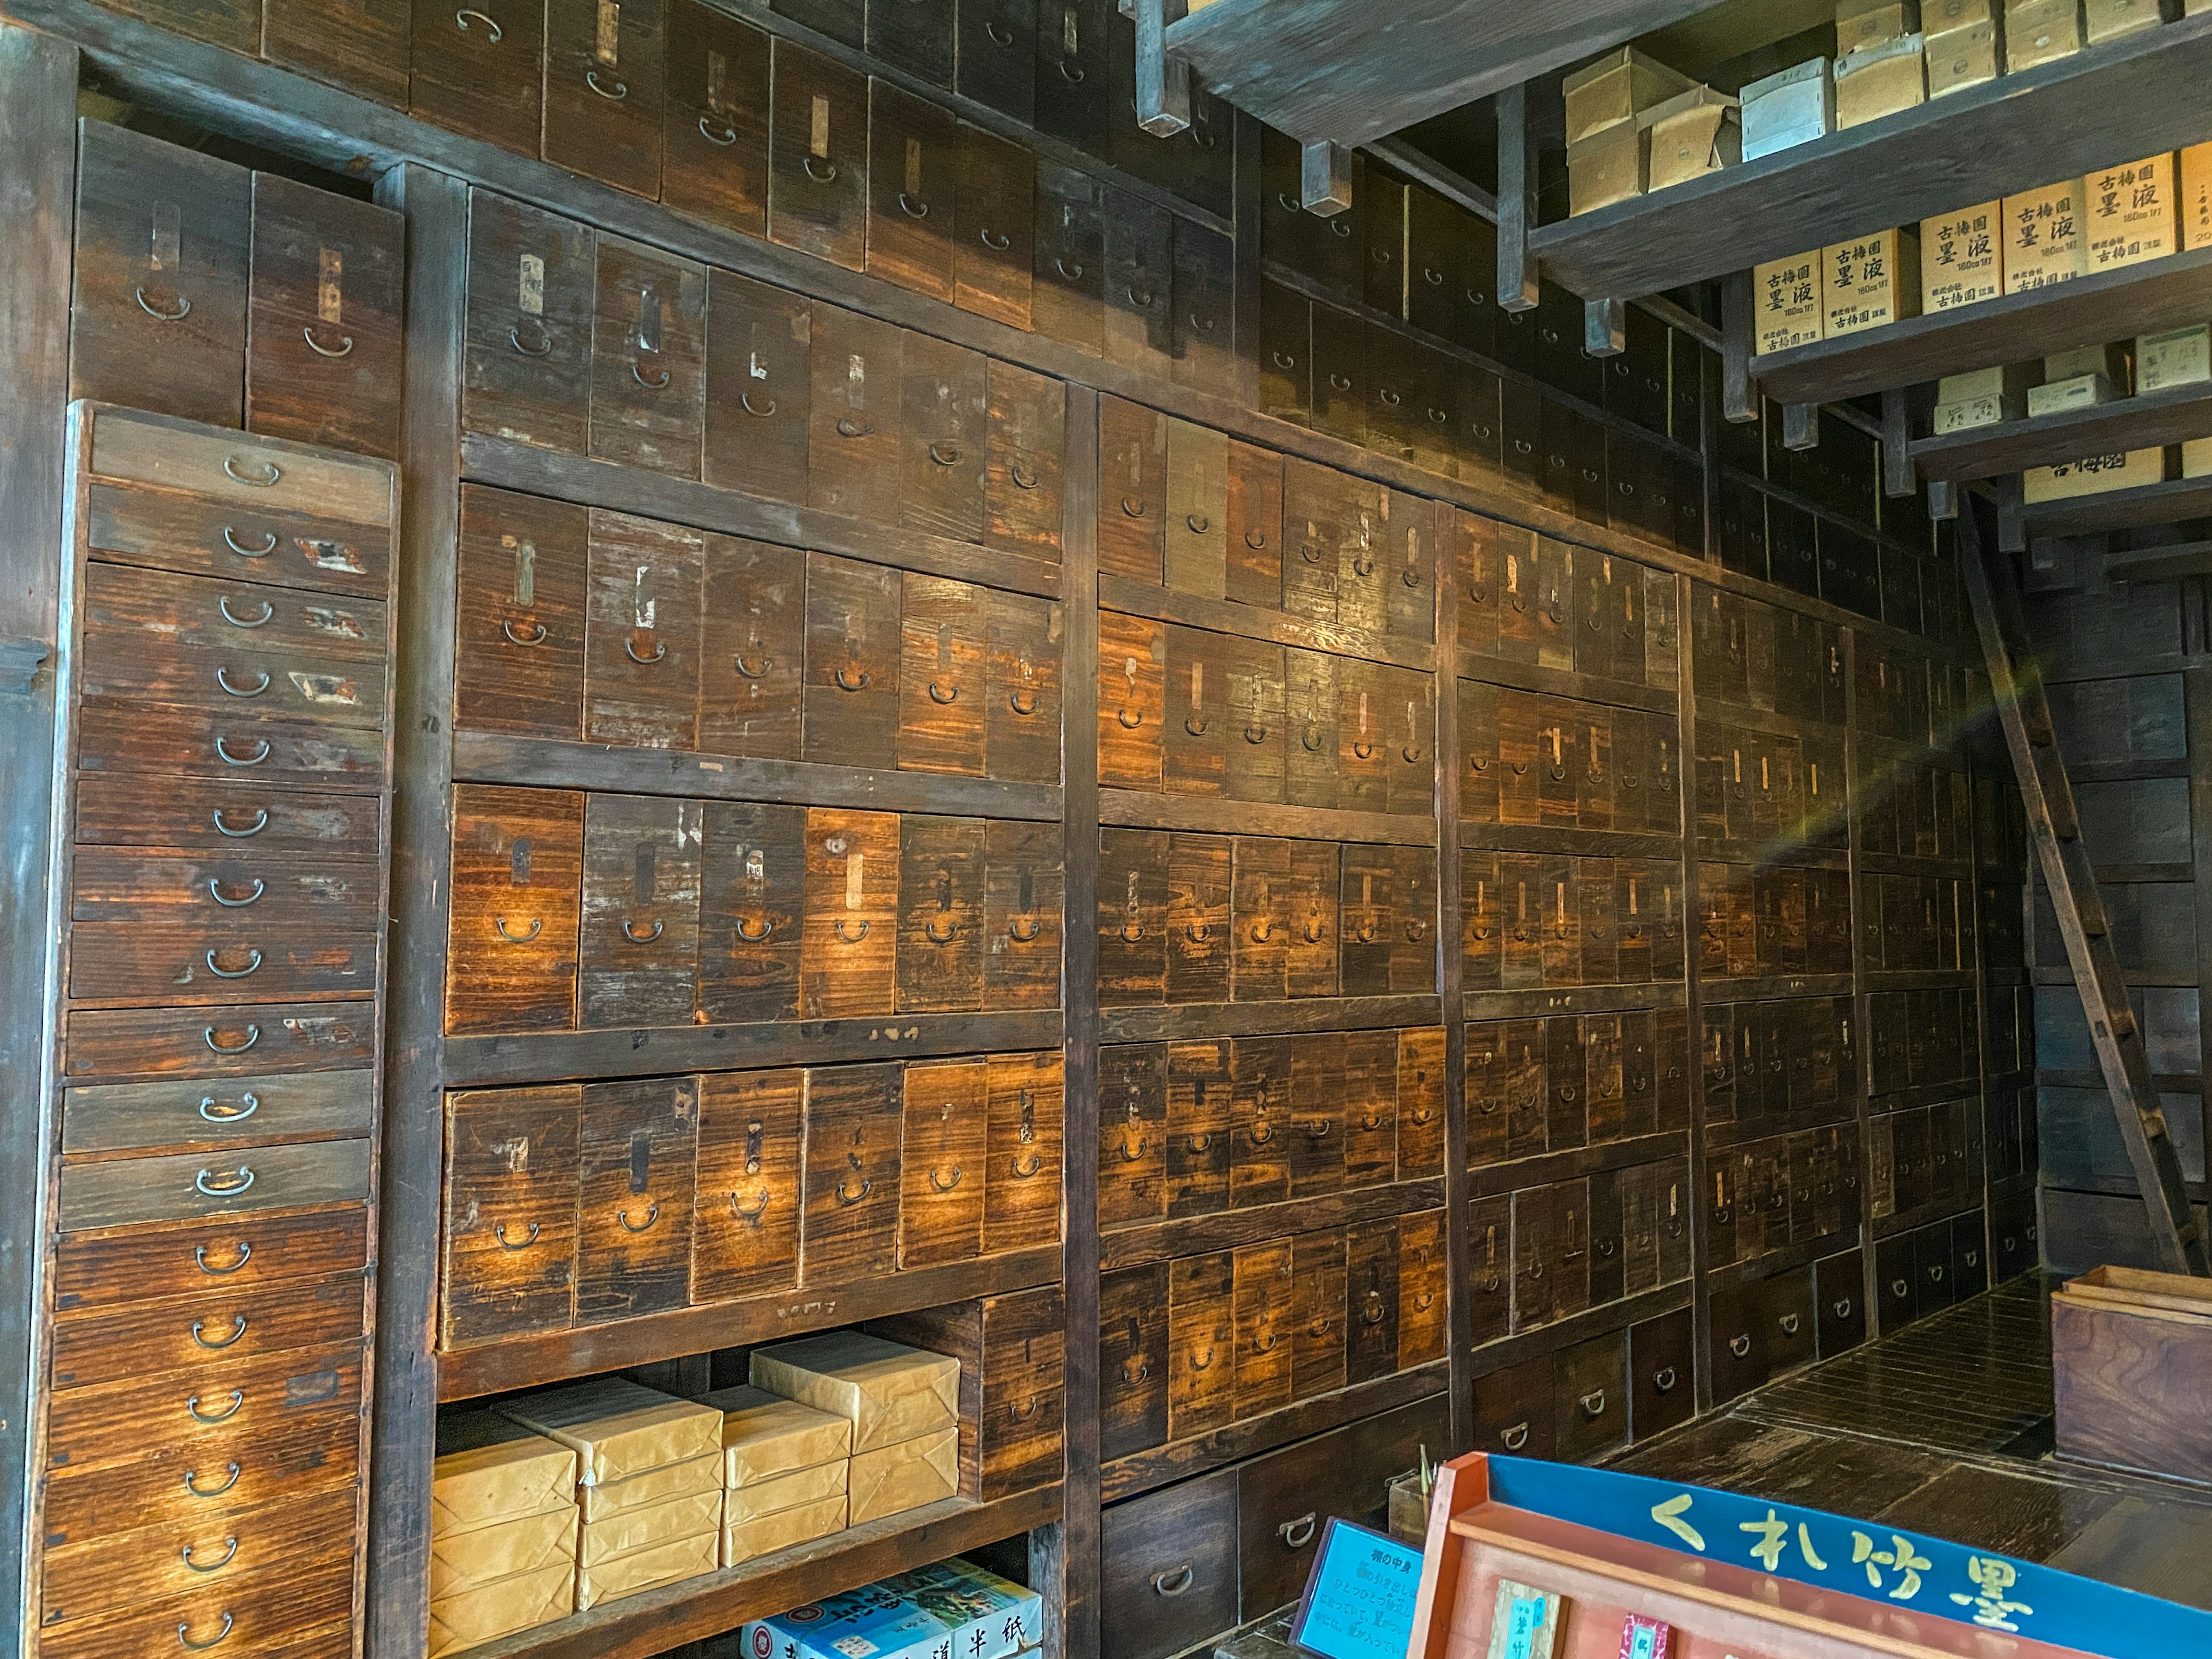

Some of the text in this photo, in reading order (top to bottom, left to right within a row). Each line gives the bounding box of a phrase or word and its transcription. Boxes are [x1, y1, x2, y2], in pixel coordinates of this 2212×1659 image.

[2099, 164, 2154, 191] 古梅園
[2018, 198, 2070, 224] 古梅園
[2096, 184, 2159, 218] 墨液
[1938, 215, 1987, 240] 古梅園
[2016, 216, 2076, 248] 墨液
[1836, 240, 1881, 264] 古梅園
[1936, 234, 1993, 266] 墨液
[2097, 241, 2140, 263] 古梅園
[1767, 265, 1810, 288] 古梅園
[1834, 258, 1885, 288] 墨液
[1766, 283, 1814, 311] 墨液
[1937, 288, 1975, 308] 古梅園
[1835, 310, 1869, 328] 古梅園
[1767, 333, 1800, 351] 古梅園
